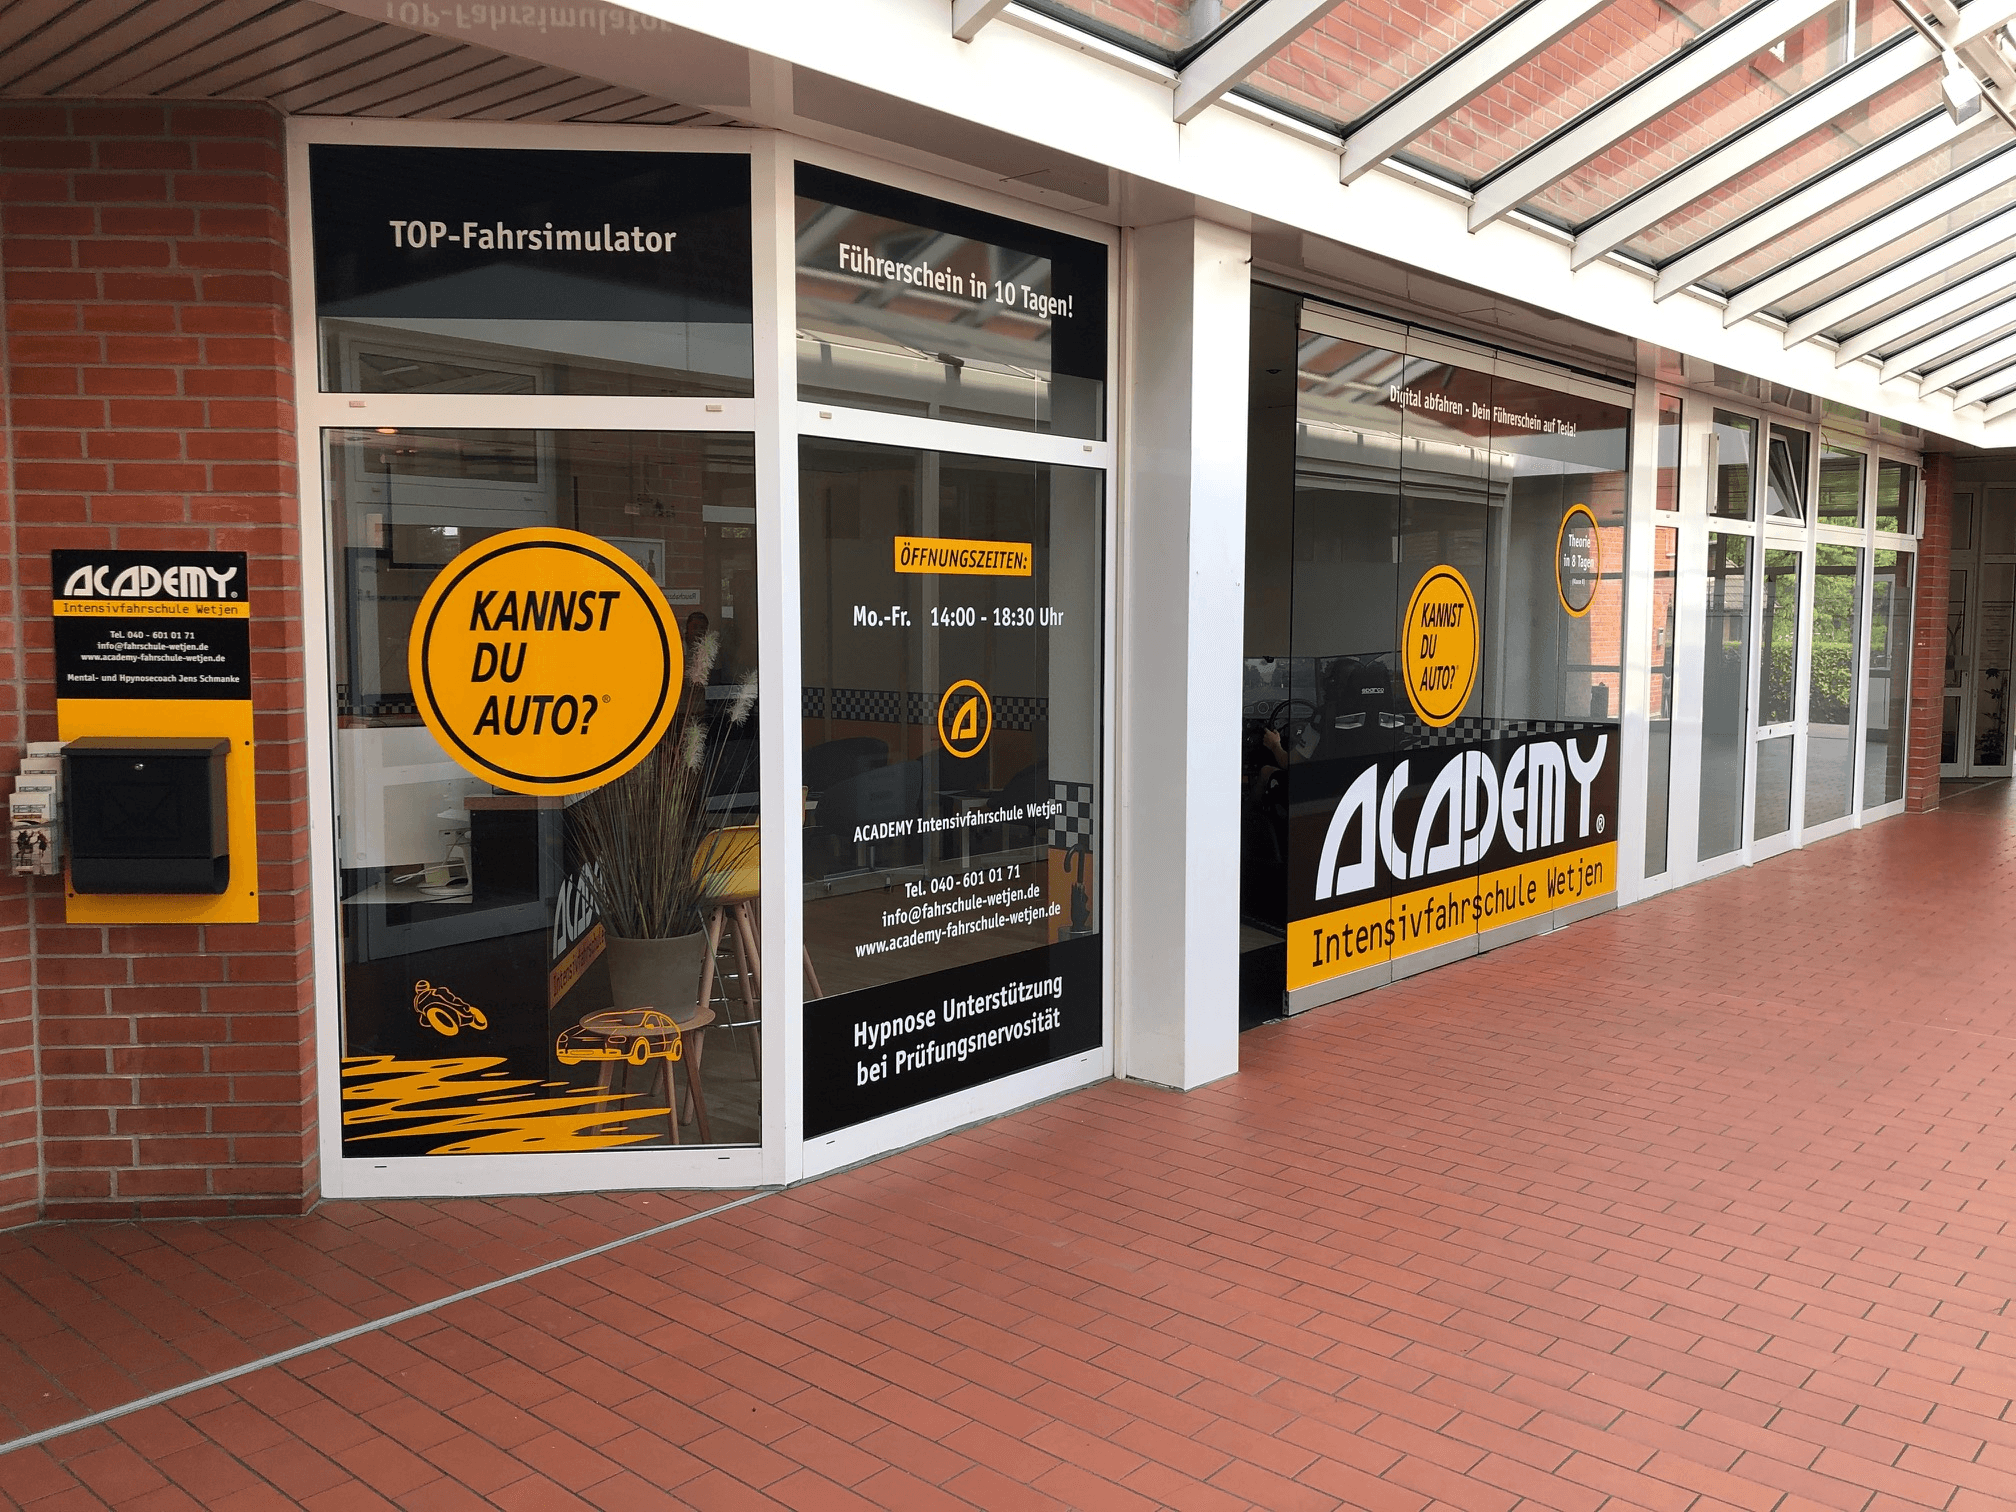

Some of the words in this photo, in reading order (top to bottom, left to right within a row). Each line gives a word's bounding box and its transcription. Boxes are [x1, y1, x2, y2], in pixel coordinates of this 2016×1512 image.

[389, 220, 677, 253] TOP-Fahrsimulator
[839, 242, 963, 295] Führerschein
[969, 272, 987, 300] in
[994, 280, 1016, 306] 10
[1020, 284, 1073, 319] Tagen!
[1390, 384, 1422, 408] Digital
[1424, 390, 1463, 416] abfahren
[1472, 402, 1491, 421] Dein
[1493, 406, 1542, 431] Führerschein
[1543, 417, 1556, 433] auf
[1557, 419, 1577, 438] Tesla!
[900, 541, 1028, 570] ÖFFNUNGSZEITEN:
[1568, 533, 1591, 548] Theorie
[1563, 553, 1571, 567] in
[1571, 554, 1577, 567] 8
[1577, 554, 1595, 571] Tagen
[63, 602, 190, 614] Intensivfahrschule
[195, 604, 238, 616] Wetjen
[469, 590, 621, 632] KANNST
[853, 605, 912, 627] Mo.-Fr.
[930, 606, 976, 627] 14:00
[993, 607, 1035, 627] 18:30
[1039, 607, 1065, 626] Uhr
[1420, 603, 1464, 628] KANNST
[97, 641, 209, 653] info@fahrschule-wetjen.de
[109, 630, 126, 639] Tel.
[127, 631, 144, 639] 040
[152, 631, 169, 640] 601
[170, 631, 182, 640] 01
[184, 631, 195, 640] 71
[1420, 633, 1438, 659] DU
[80, 653, 226, 664] www.academy-fahrschule-wetjen.de
[470, 642, 527, 683] DU
[67, 673, 99, 682] Mental-
[101, 673, 117, 682] und
[119, 673, 177, 684] Hpynosecoach
[178, 674, 198, 683] Jens
[199, 674, 240, 683] Schmanke
[1361, 687, 1385, 695] sparco
[853, 819, 914, 843] ACADEMY
[916, 804, 1023, 834] Intensivfahrschule
[1026, 801, 1063, 820] Wetjen
[904, 881, 927, 899] Tel.
[930, 875, 954, 894] 040
[962, 870, 985, 888] 601
[988, 867, 1003, 884] 01
[1006, 864, 1021, 880] 71
[881, 884, 1040, 927] info@fahrschule-wetjen.de
[1312, 873, 1537, 968] Intensivfahrschule
[1547, 857, 1603, 898] Wetjen
[855, 902, 1061, 958] www.academy-fahrschule-wetjen.de
[854, 1009, 936, 1050] Hypnose
[943, 975, 1064, 1022] Unterstützung
[856, 1054, 887, 1087] bei
[895, 1007, 1061, 1075] Prüfungsnervosität
